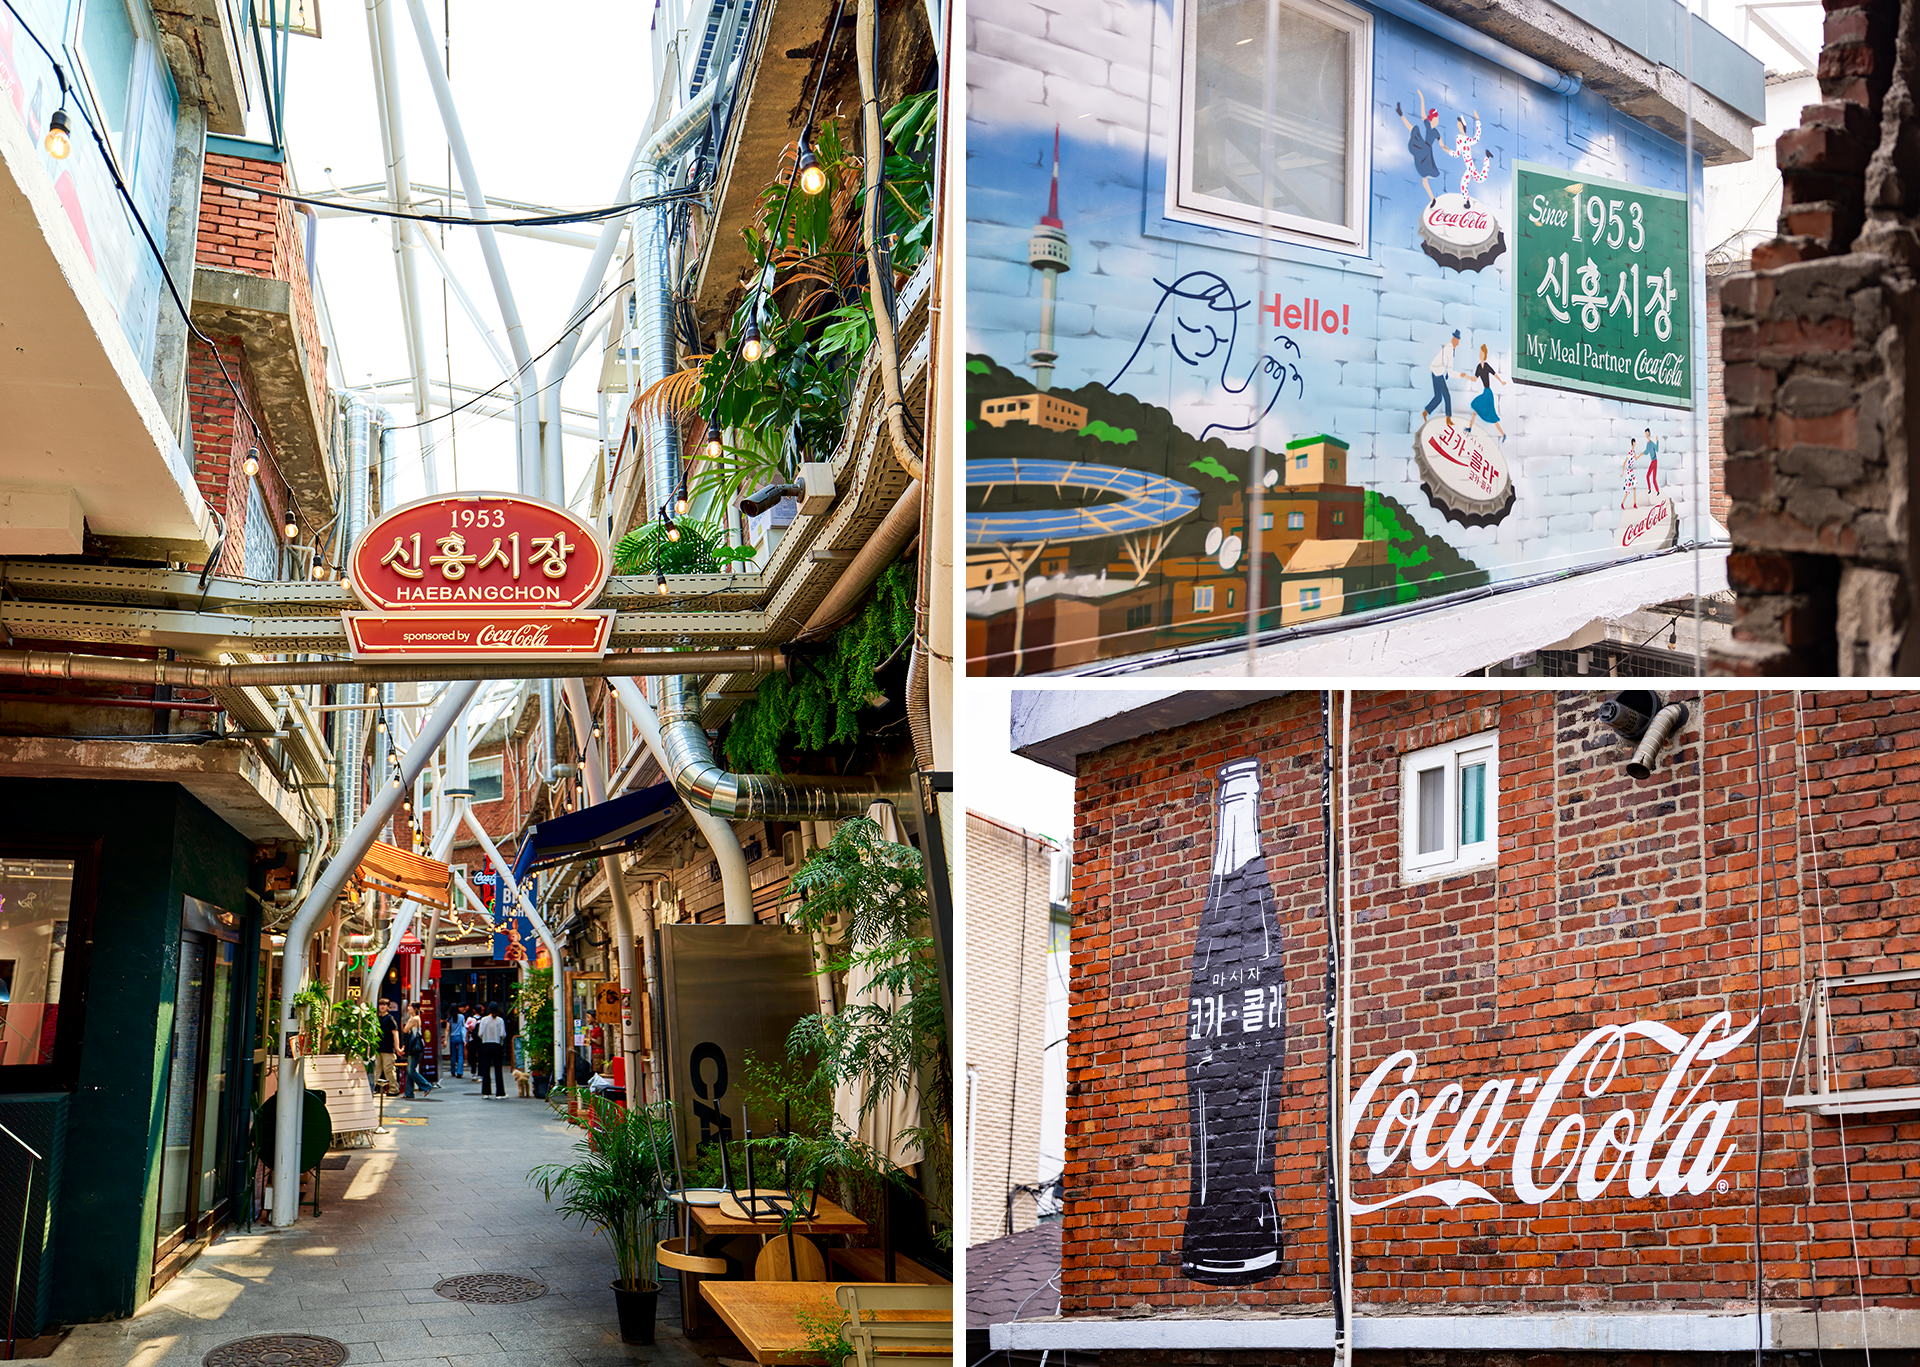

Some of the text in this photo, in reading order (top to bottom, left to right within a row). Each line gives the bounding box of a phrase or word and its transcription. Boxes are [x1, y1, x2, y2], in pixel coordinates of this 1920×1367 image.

[1428, 207, 1488, 230] Coca-Cola
[1528, 193, 1646, 253] Since 1953
[1258, 290, 1350, 336] Hello!
[1536, 251, 1678, 342] 신흥시장
[1526, 333, 1686, 387] My Meal Partner Coca-Cola
[450, 508, 506, 529] 1953
[1622, 499, 1668, 547] Coca-Cola
[380, 530, 576, 581] 신흥시장
[396, 585, 560, 600] HAEBANGCHON
[402, 623, 553, 648] sponsored by Coca-Cola
[1212, 966, 1260, 986] 마시자
[1349, 1003, 1767, 1216] Coca-Cola
